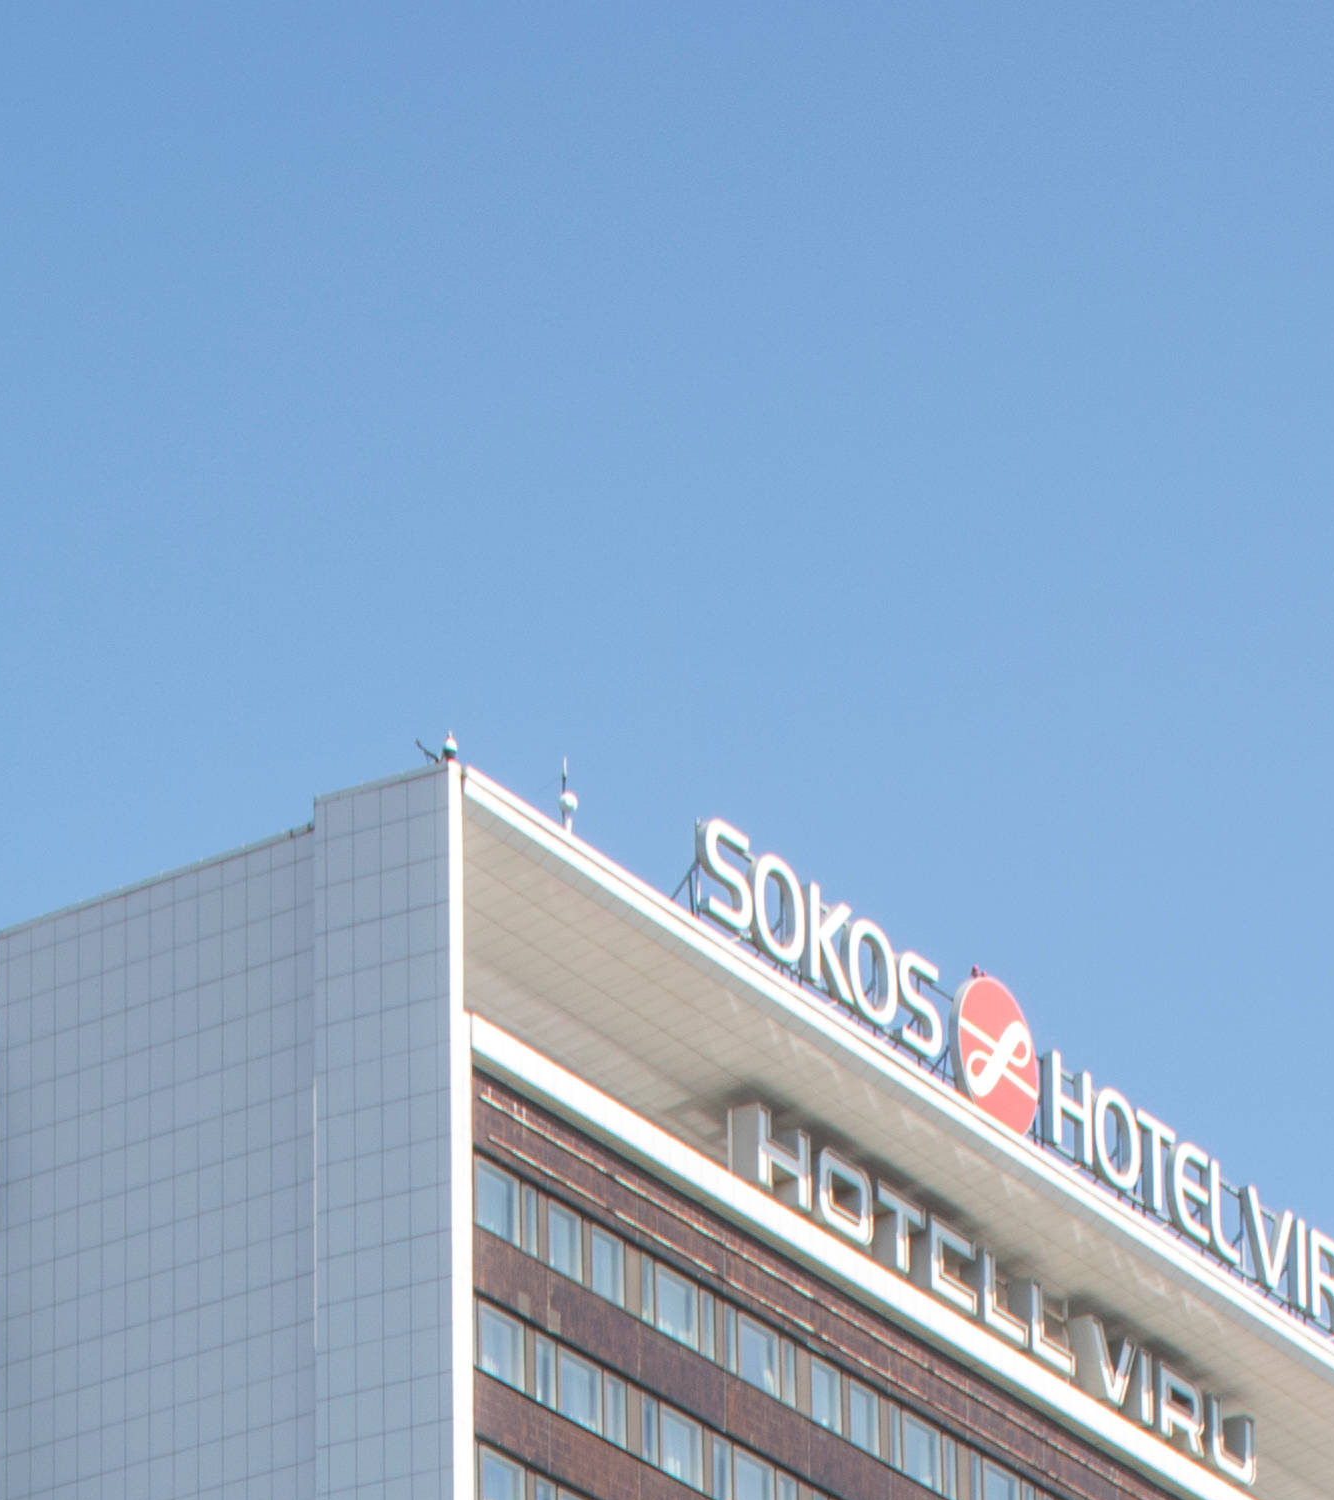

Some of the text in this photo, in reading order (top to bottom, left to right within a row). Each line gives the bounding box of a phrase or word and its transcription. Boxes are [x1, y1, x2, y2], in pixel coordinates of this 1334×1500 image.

[699, 817, 943, 1057] SOKOS
[1047, 1049, 1241, 1266] HOTEL
[750, 1102, 1257, 1486] HOTELL VIRU
